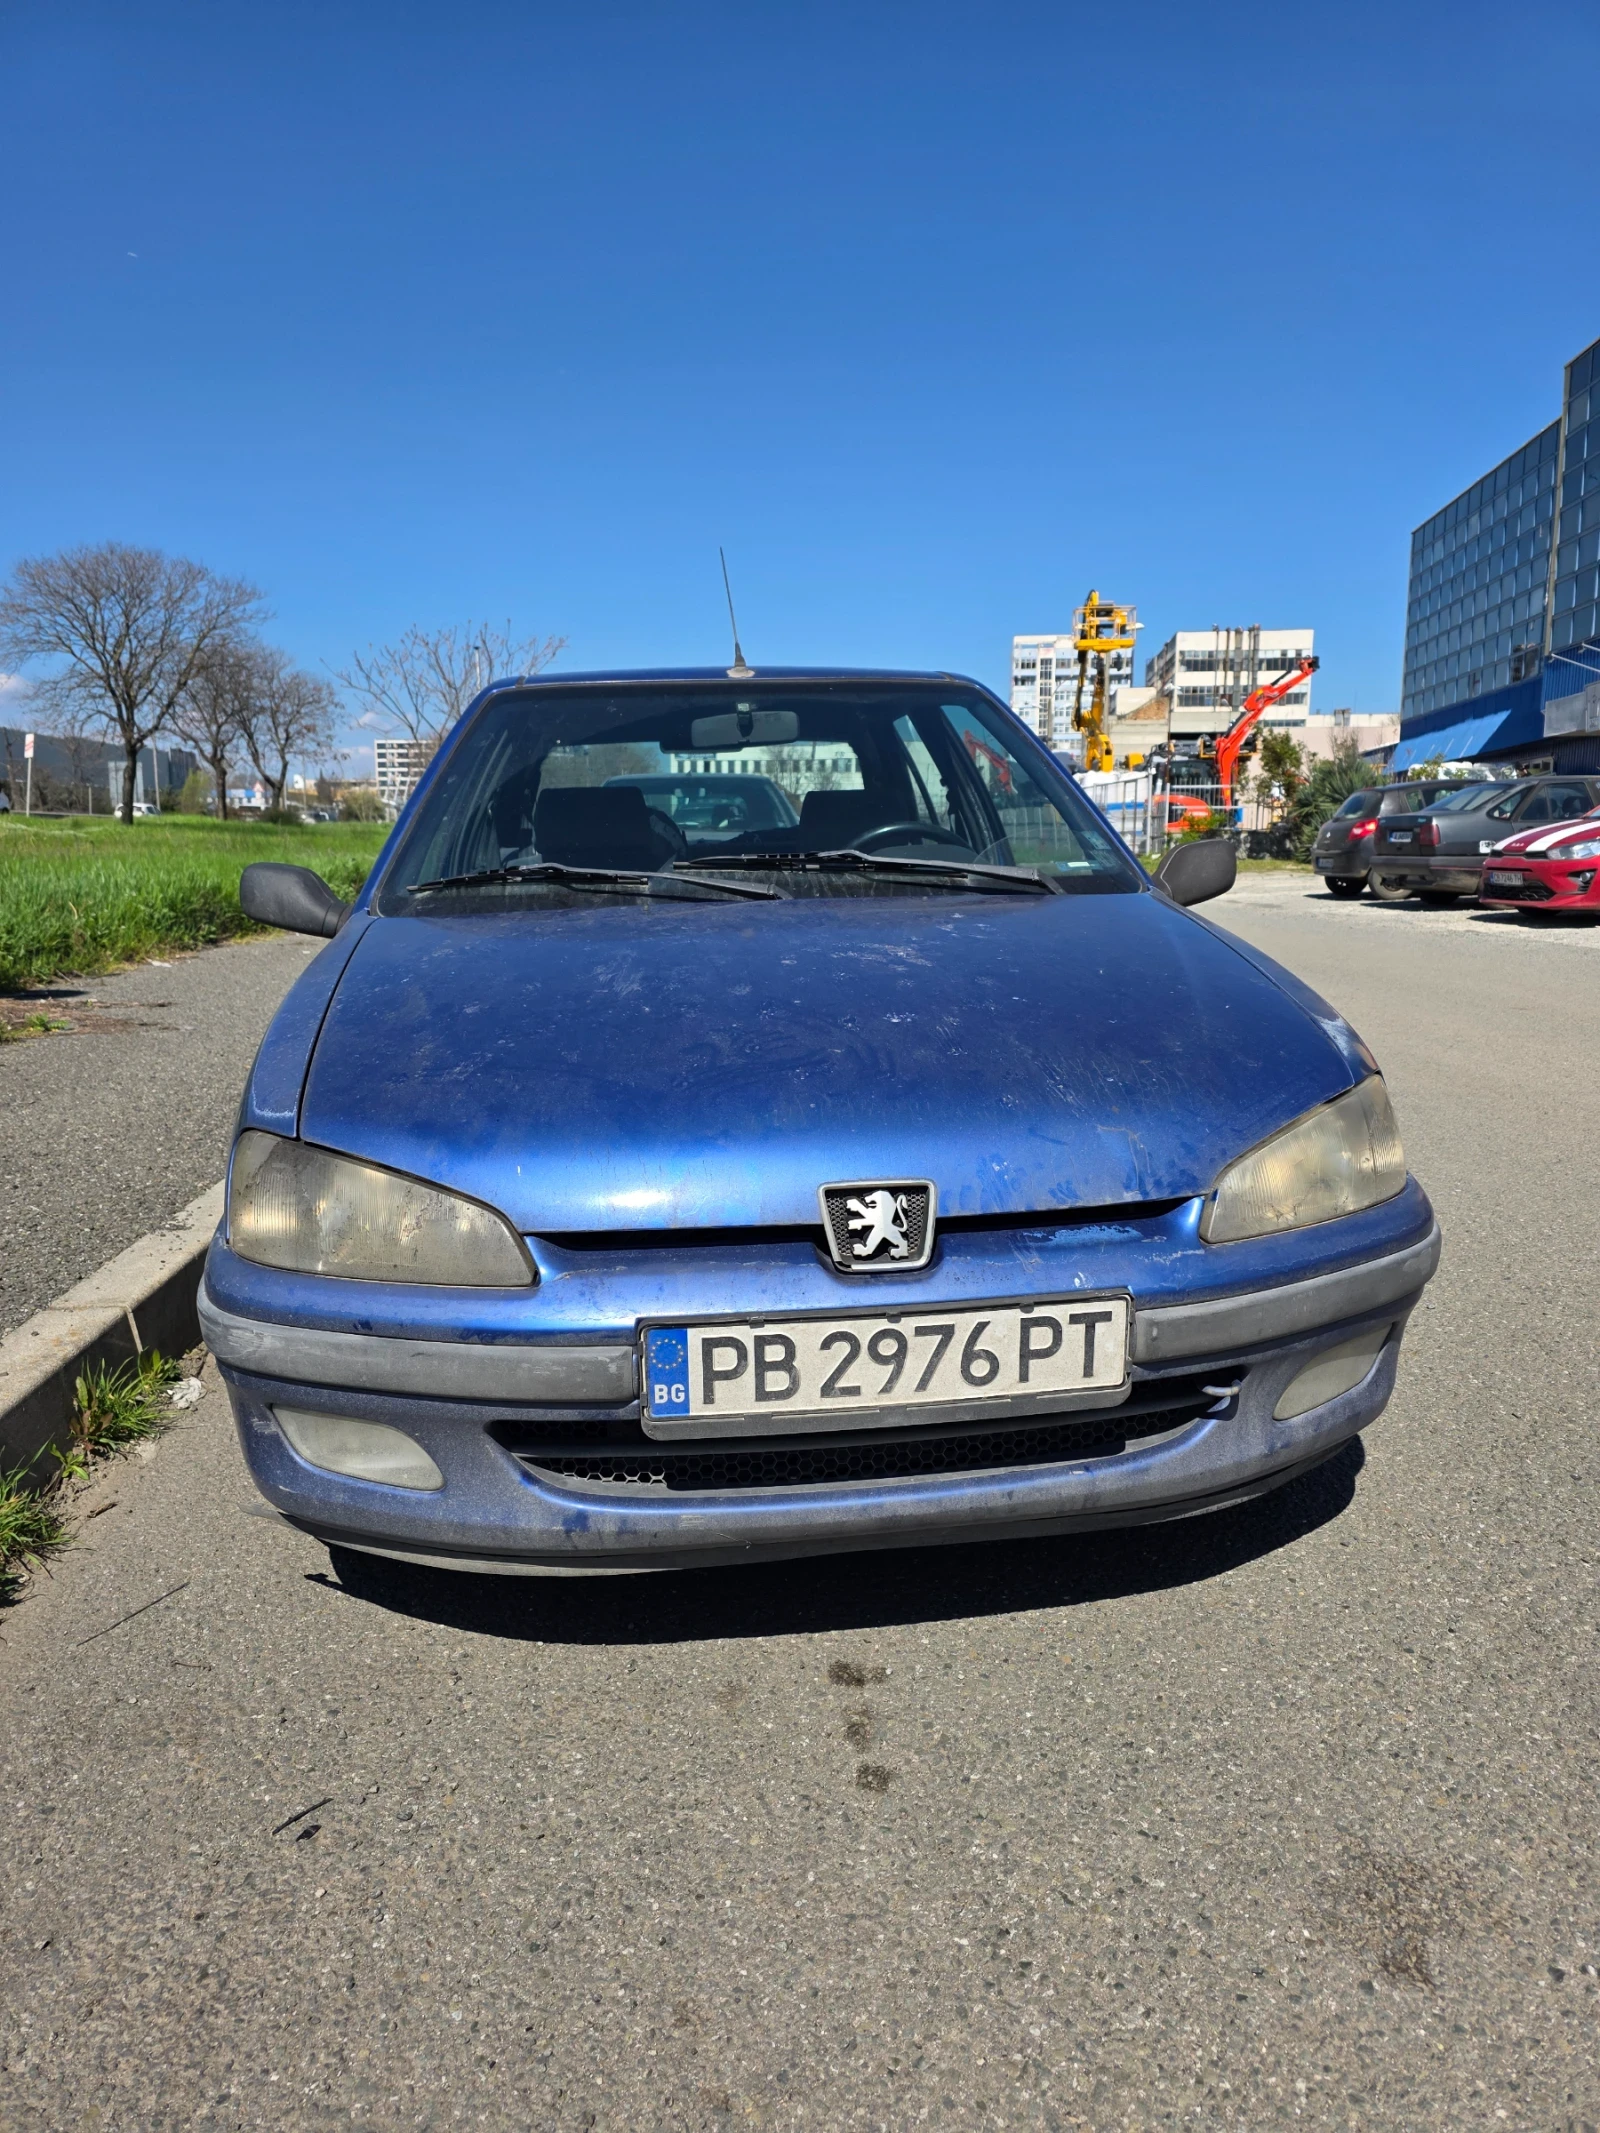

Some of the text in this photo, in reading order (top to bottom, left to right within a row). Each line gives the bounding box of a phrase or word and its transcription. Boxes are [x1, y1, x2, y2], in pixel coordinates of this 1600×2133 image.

[702, 1311, 1112, 1404] PB 2976 PT
[654, 1384, 685, 1403] BG
